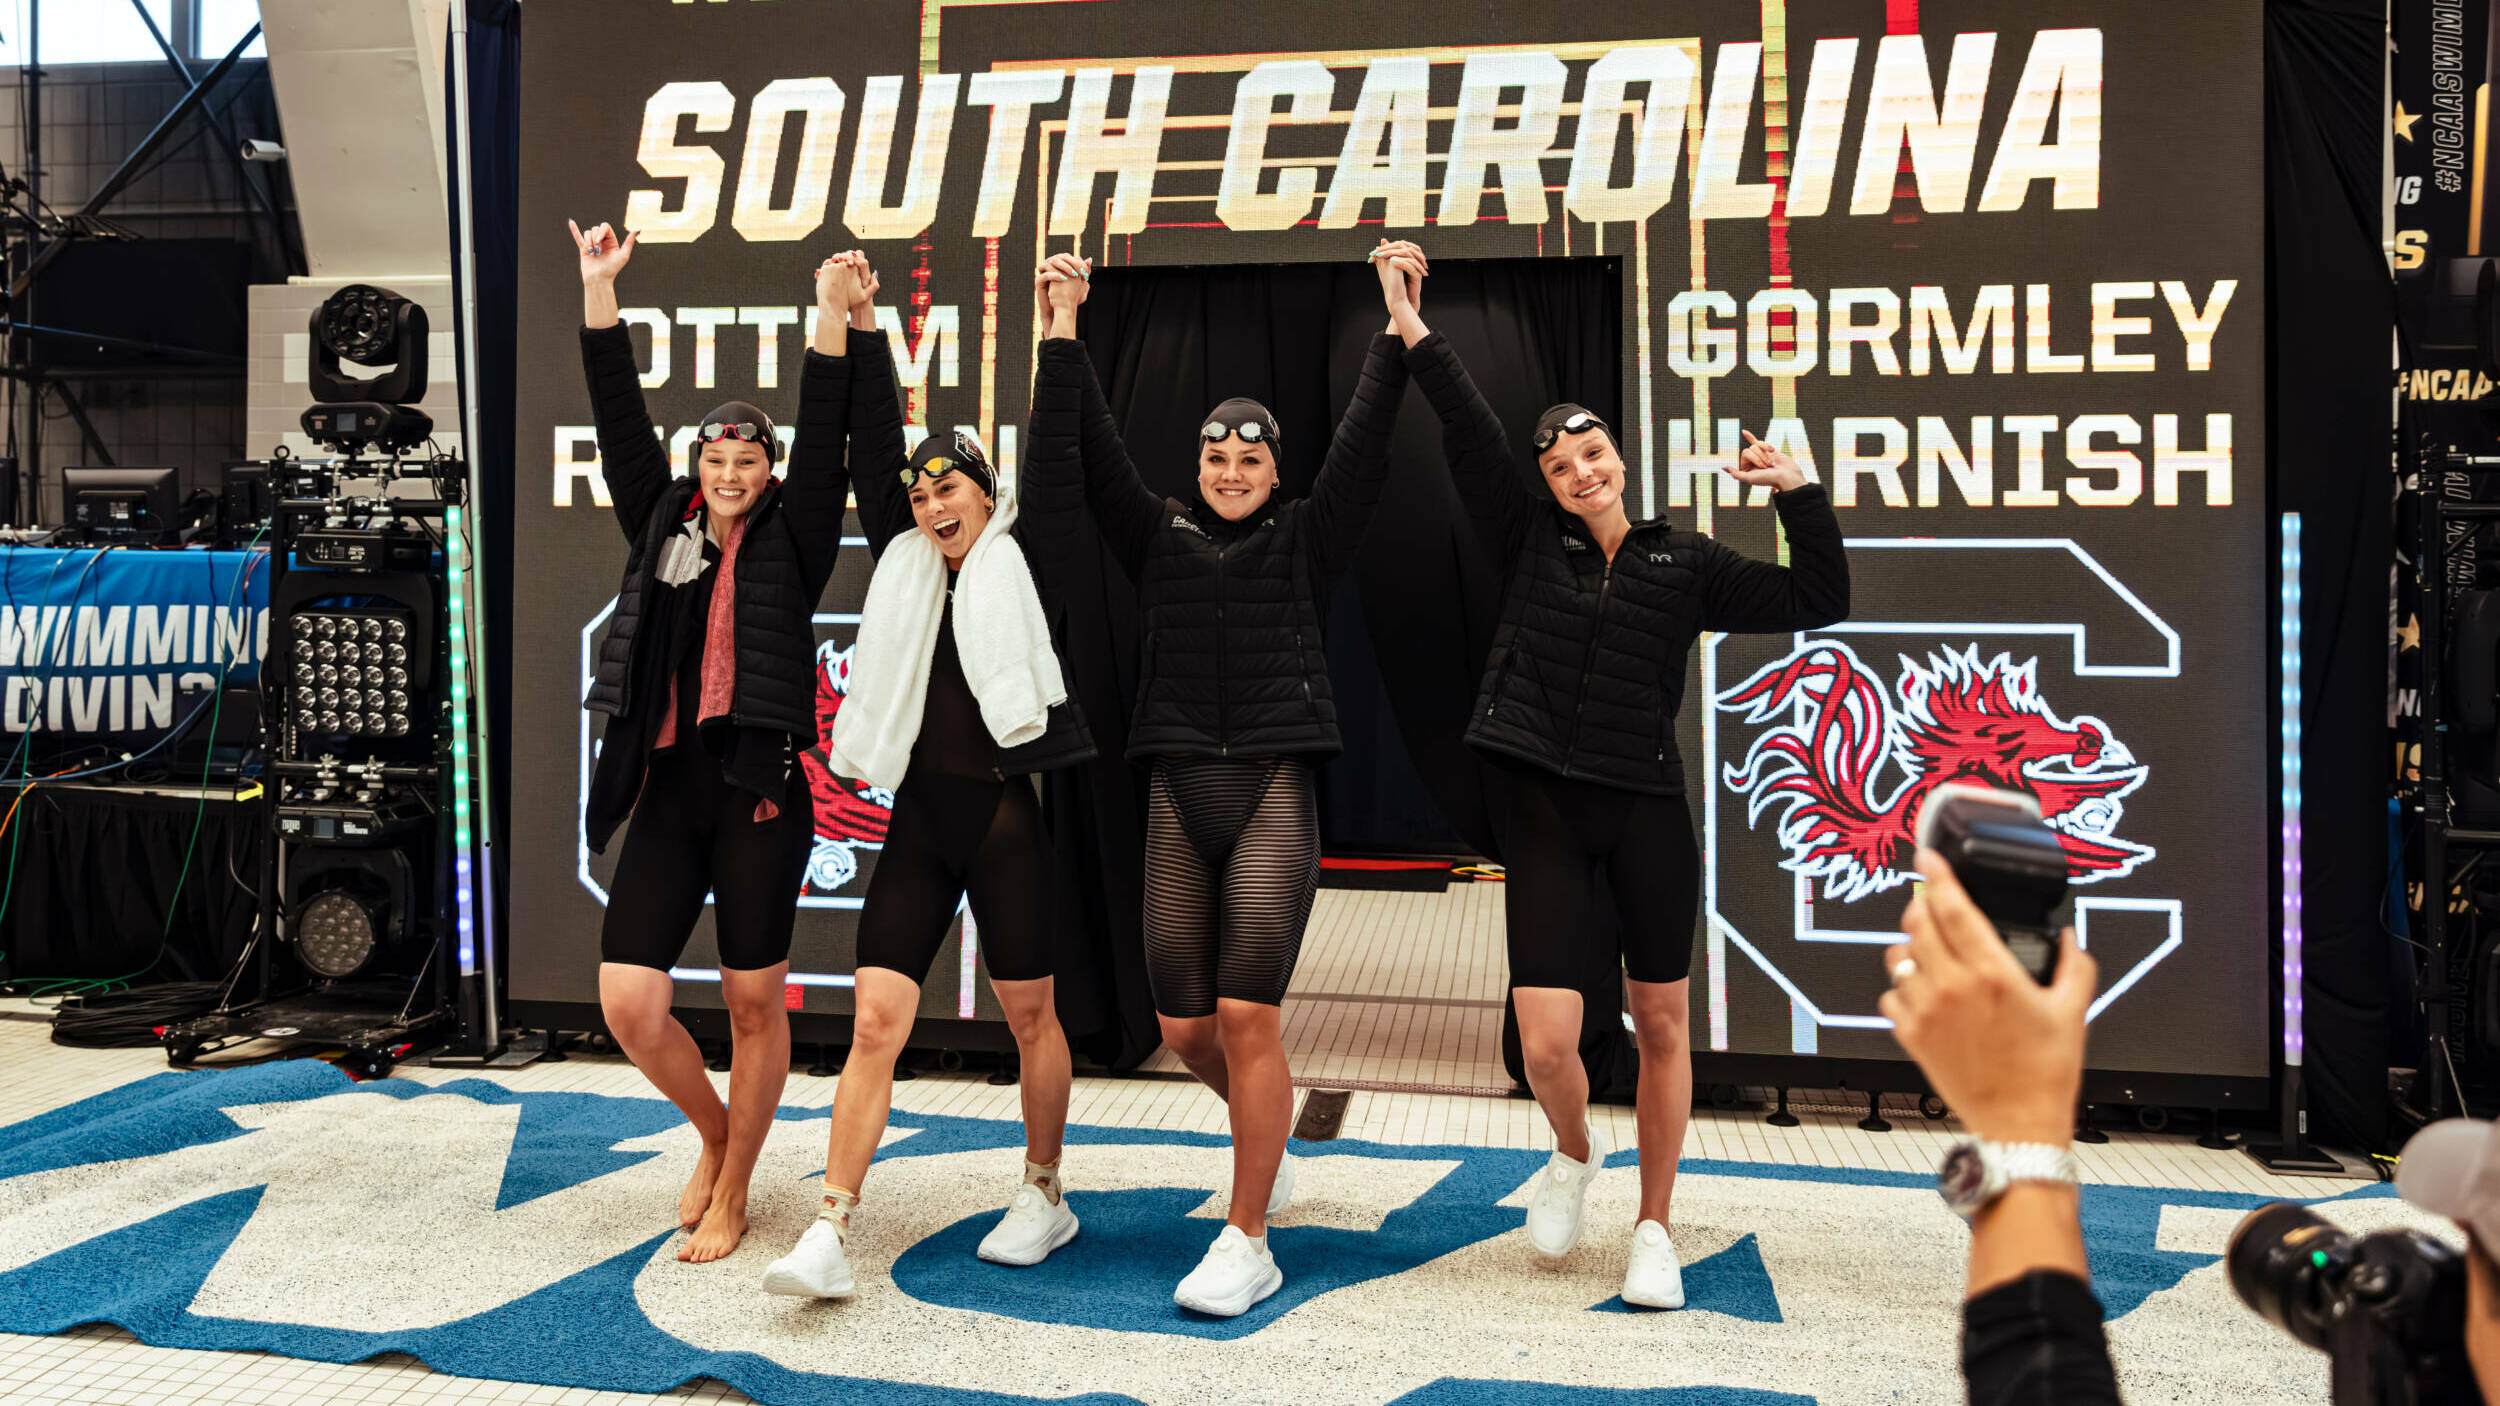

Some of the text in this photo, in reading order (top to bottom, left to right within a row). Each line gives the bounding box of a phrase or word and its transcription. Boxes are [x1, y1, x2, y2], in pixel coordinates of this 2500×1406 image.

[624, 28, 2103, 243] SOUTH CAROLINA
[1667, 279, 2238, 378] GORMLEY
[1667, 412, 2233, 508] HARNISH
[1648, 553, 1673, 563] TYR
